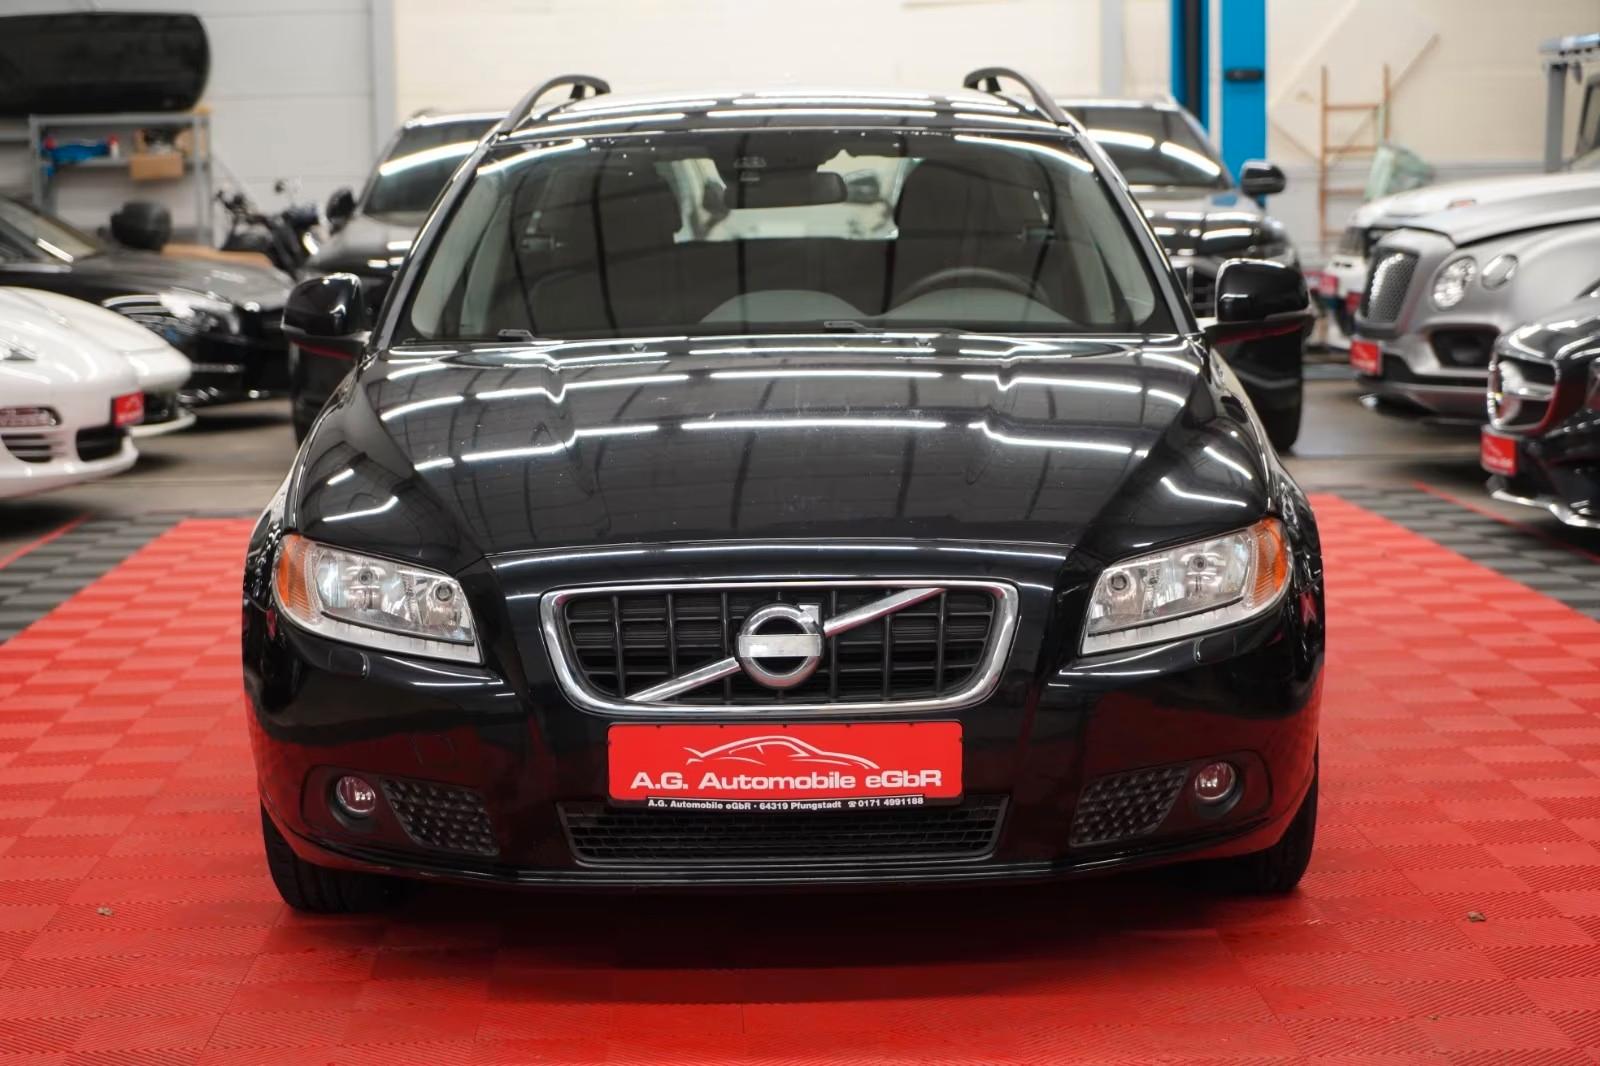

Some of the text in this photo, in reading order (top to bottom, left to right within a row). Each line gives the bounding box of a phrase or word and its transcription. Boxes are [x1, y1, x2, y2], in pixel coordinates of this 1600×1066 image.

[630, 769, 942, 790] A.G. Automobile eGbR
[648, 799, 668, 807] A.G.
[670, 800, 723, 809] Automobile
[725, 801, 751, 810] eGbR
[759, 801, 789, 810] 64319
[790, 801, 842, 811] Pfungstadt
[857, 799, 881, 807] 0171
